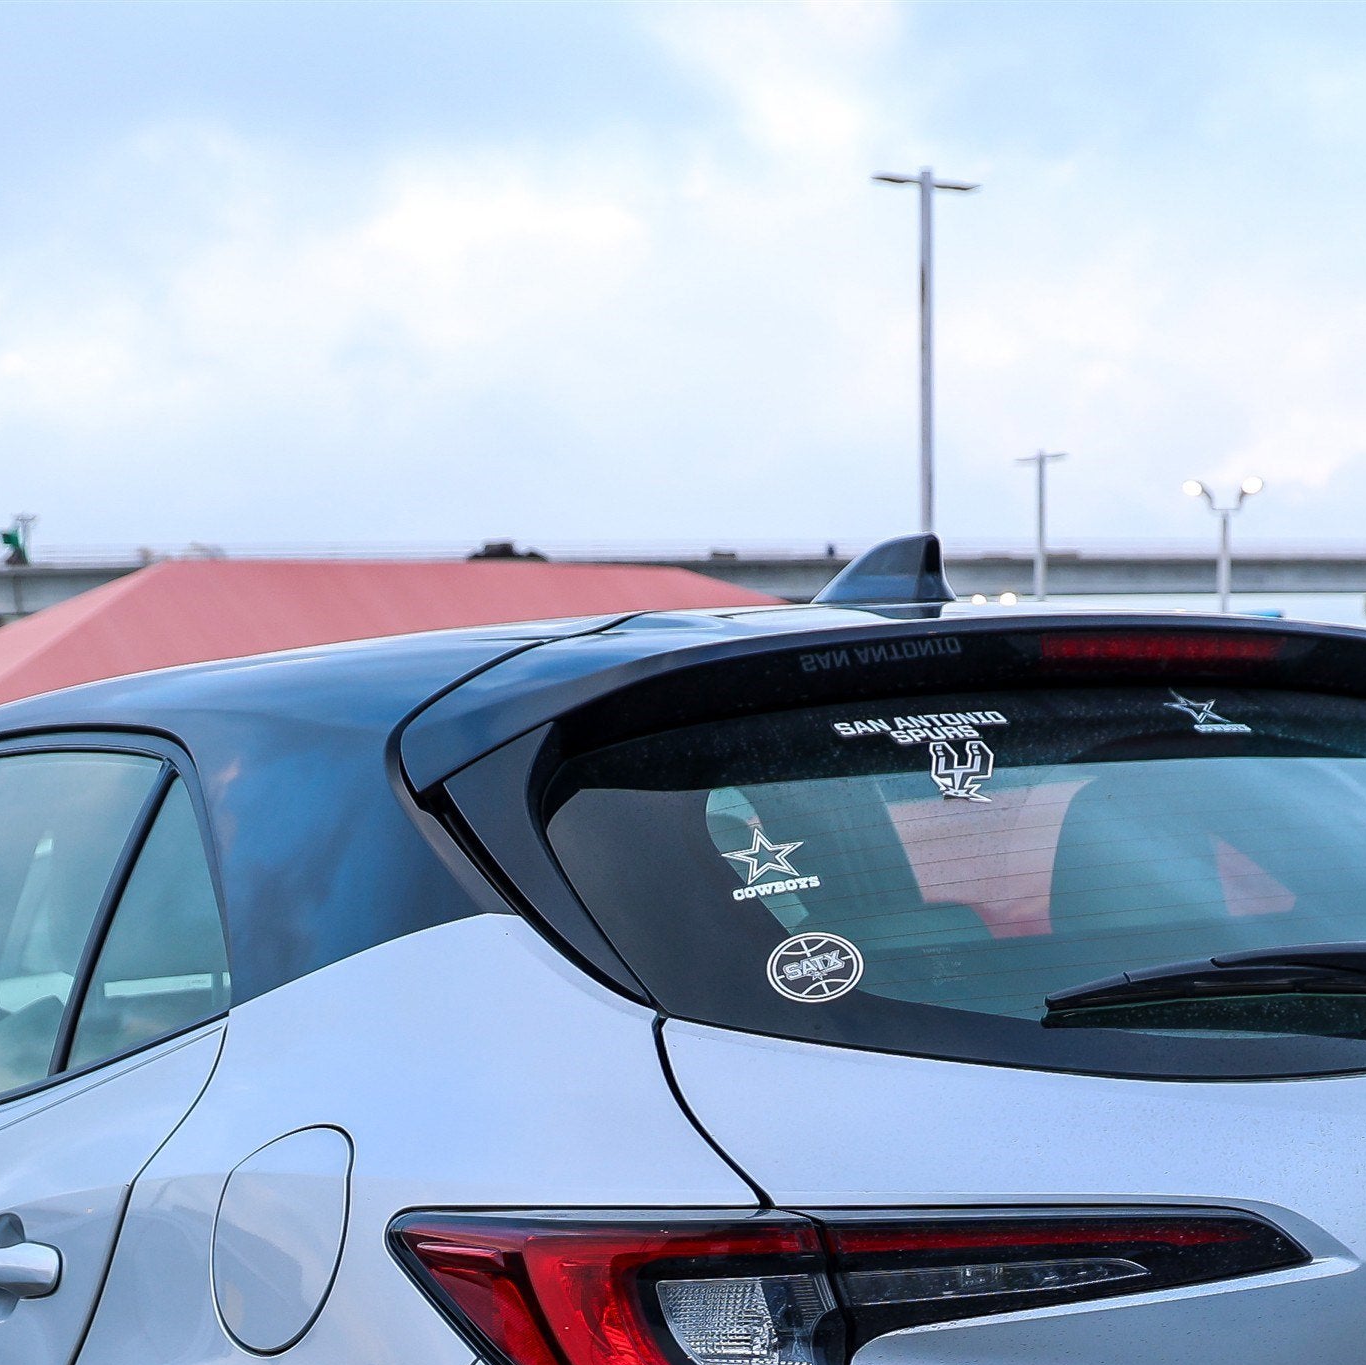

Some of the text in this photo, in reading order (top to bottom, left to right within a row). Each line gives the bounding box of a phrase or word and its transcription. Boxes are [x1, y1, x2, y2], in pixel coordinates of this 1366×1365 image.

[833, 710, 1009, 737] SAN ANTONIO
[889, 725, 982, 744] SPURS
[732, 876, 821, 901] COWBOYS
[782, 949, 846, 981] SATX
